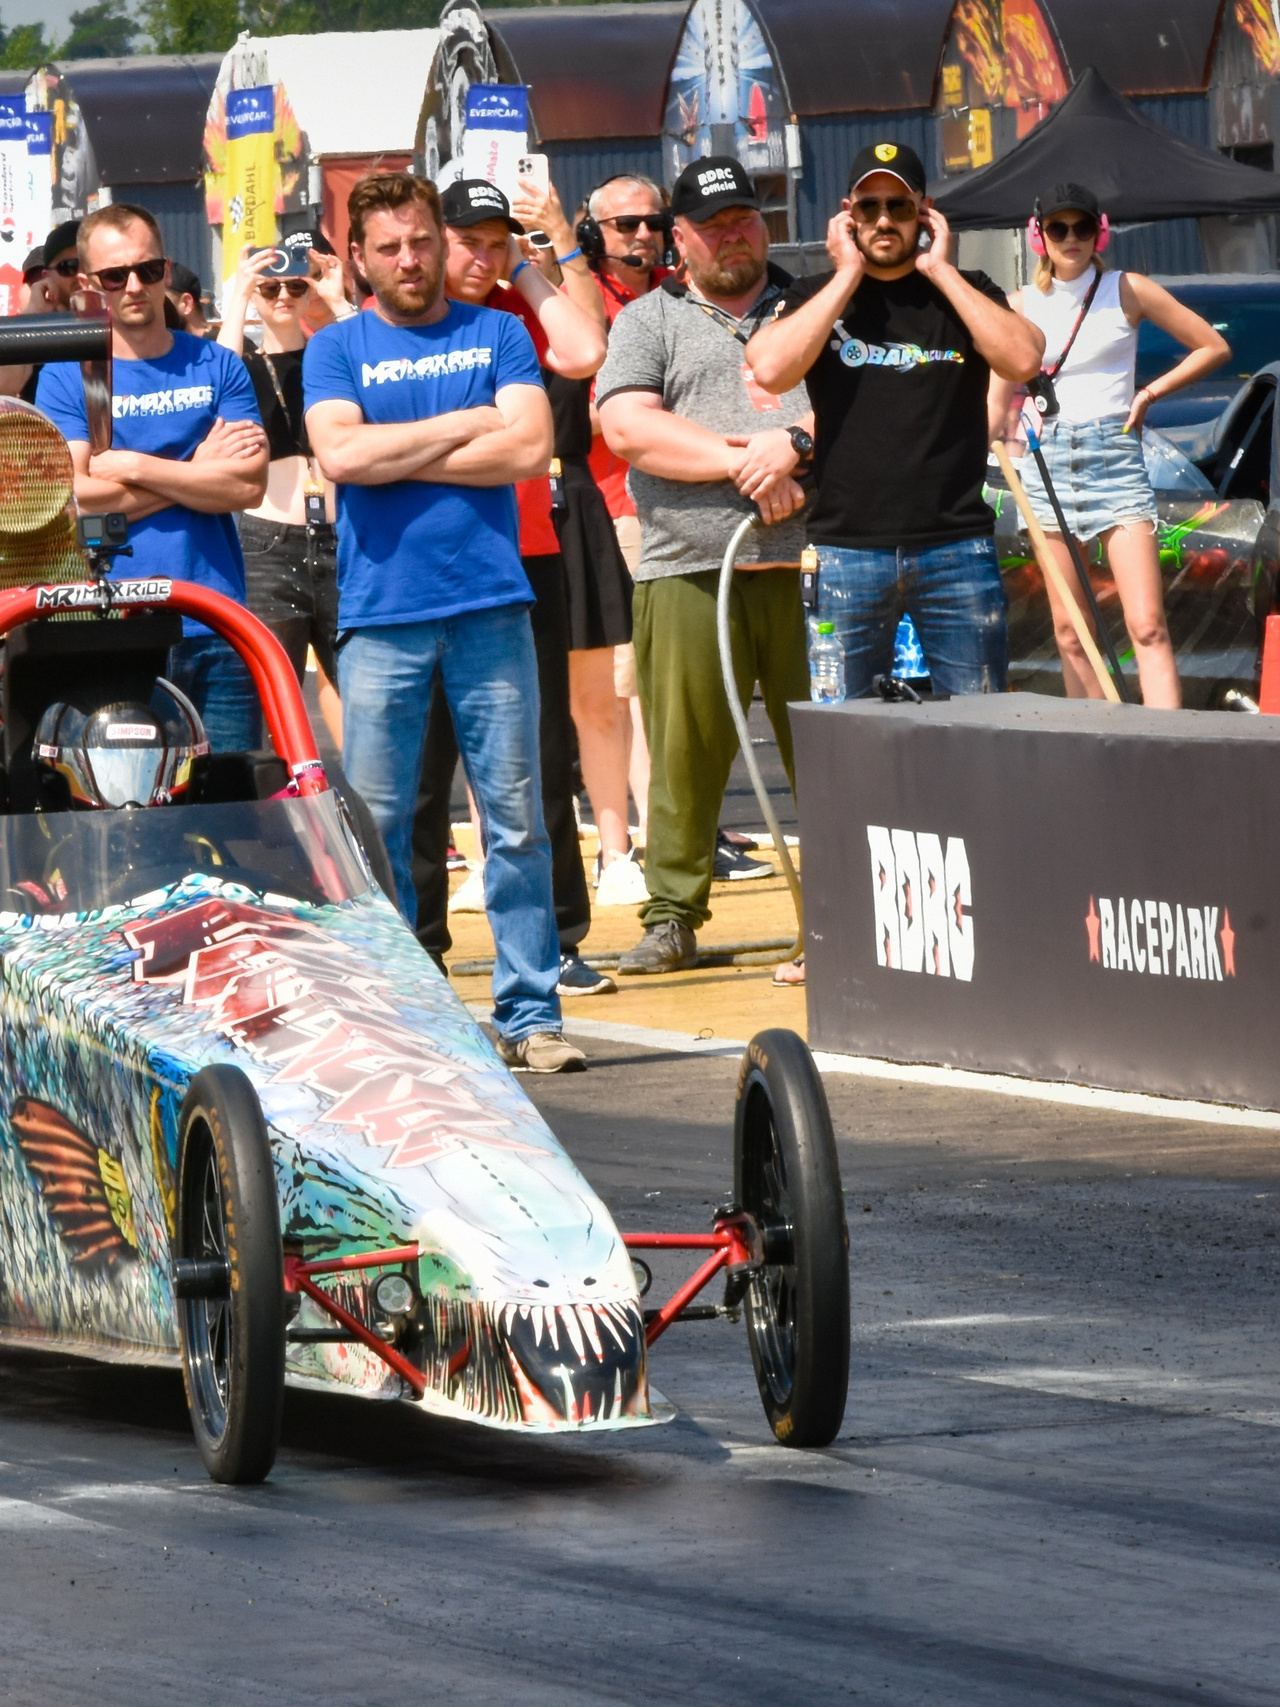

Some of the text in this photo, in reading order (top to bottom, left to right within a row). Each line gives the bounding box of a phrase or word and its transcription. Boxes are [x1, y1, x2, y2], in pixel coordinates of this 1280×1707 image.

[698, 168, 734, 186] RDRC
[701, 181, 737, 196] Official
[245, 162, 260, 241] BARDAHL
[111, 725, 152, 737] SIMPSON
[867, 825, 975, 982] RDRC
[1098, 896, 1223, 982] RACEPARK
